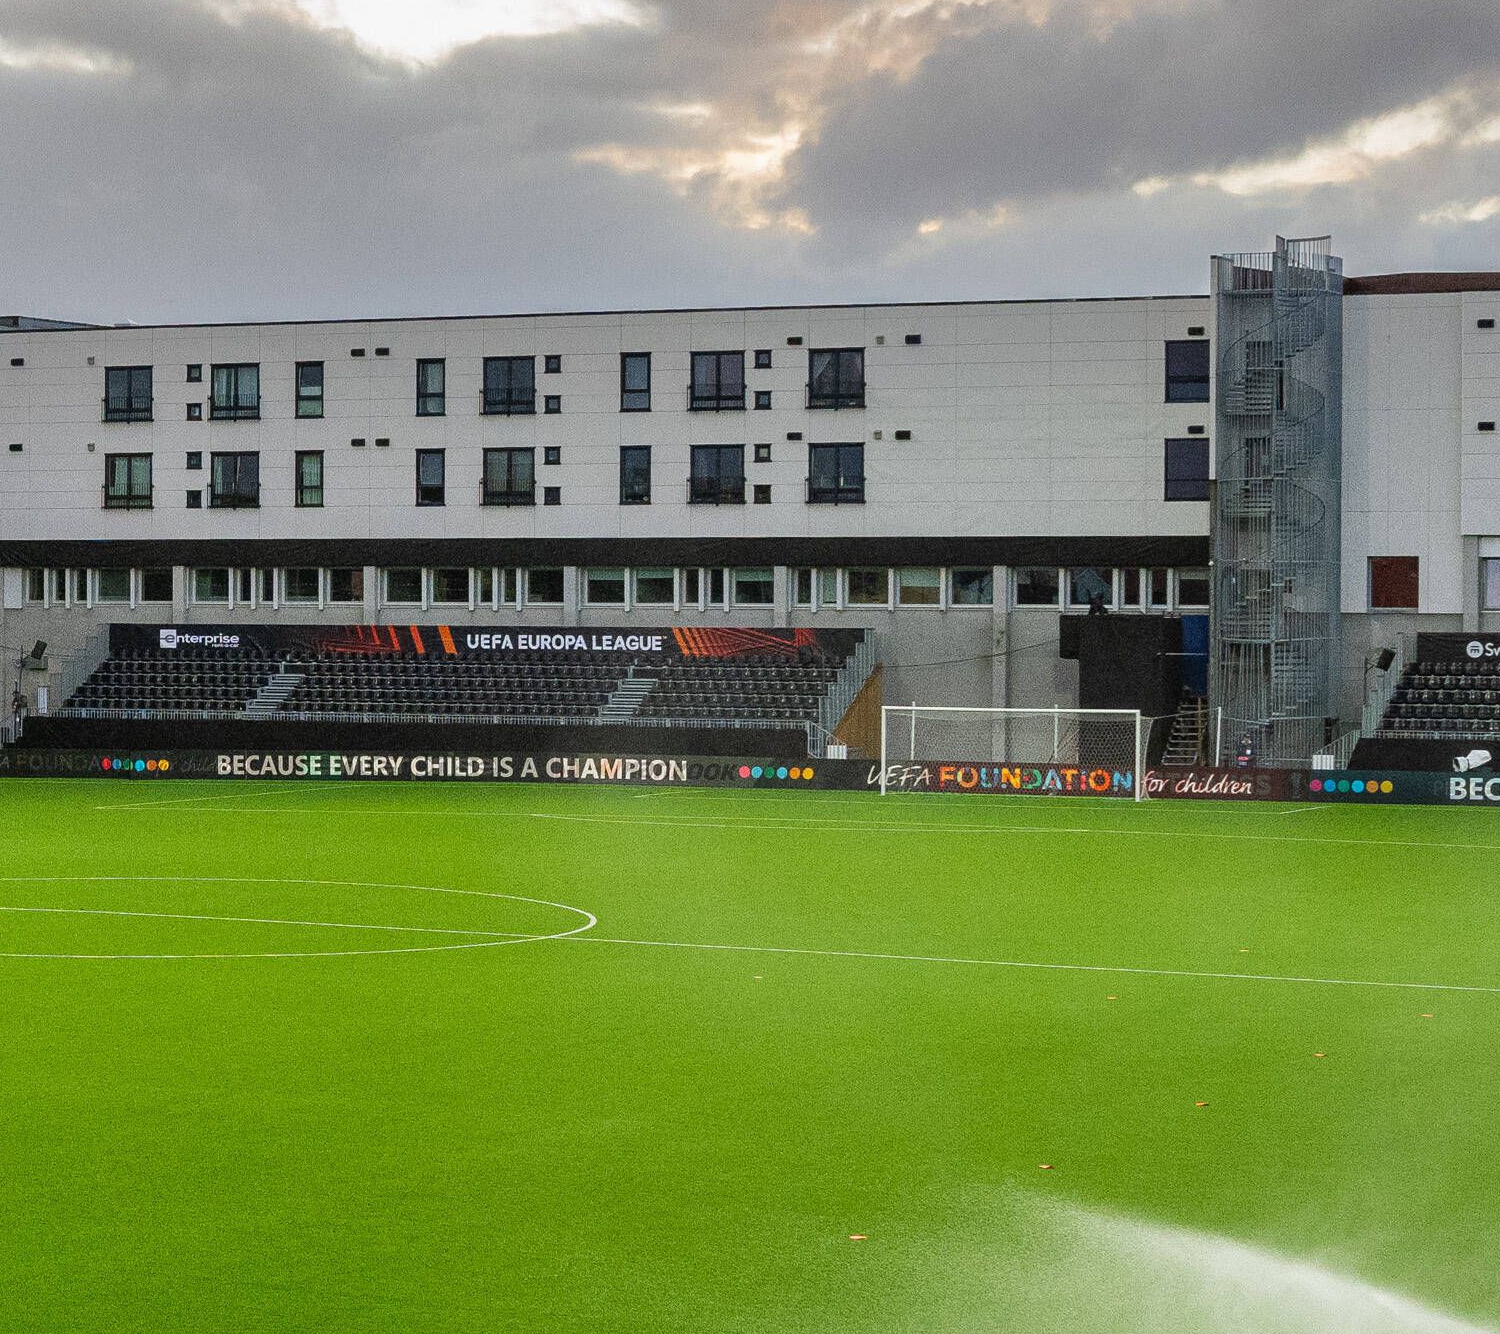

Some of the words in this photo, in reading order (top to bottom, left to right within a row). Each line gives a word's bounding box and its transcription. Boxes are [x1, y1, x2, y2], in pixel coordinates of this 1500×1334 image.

[160, 632, 240, 646] enterprise
[467, 634, 513, 650] UEFA
[518, 634, 588, 651] EUROPA
[217, 755, 322, 776] BECAUSE
[329, 755, 403, 776] EVERY
[411, 755, 484, 777] CHILD
[493, 756, 514, 778] IS
[520, 757, 539, 778] A
[546, 757, 688, 781] CHAMPION
[867, 765, 933, 787] UEFA
[939, 766, 1132, 792] FOUNDATION
[1141, 770, 1167, 797] for
[1175, 773, 1252, 795] children
